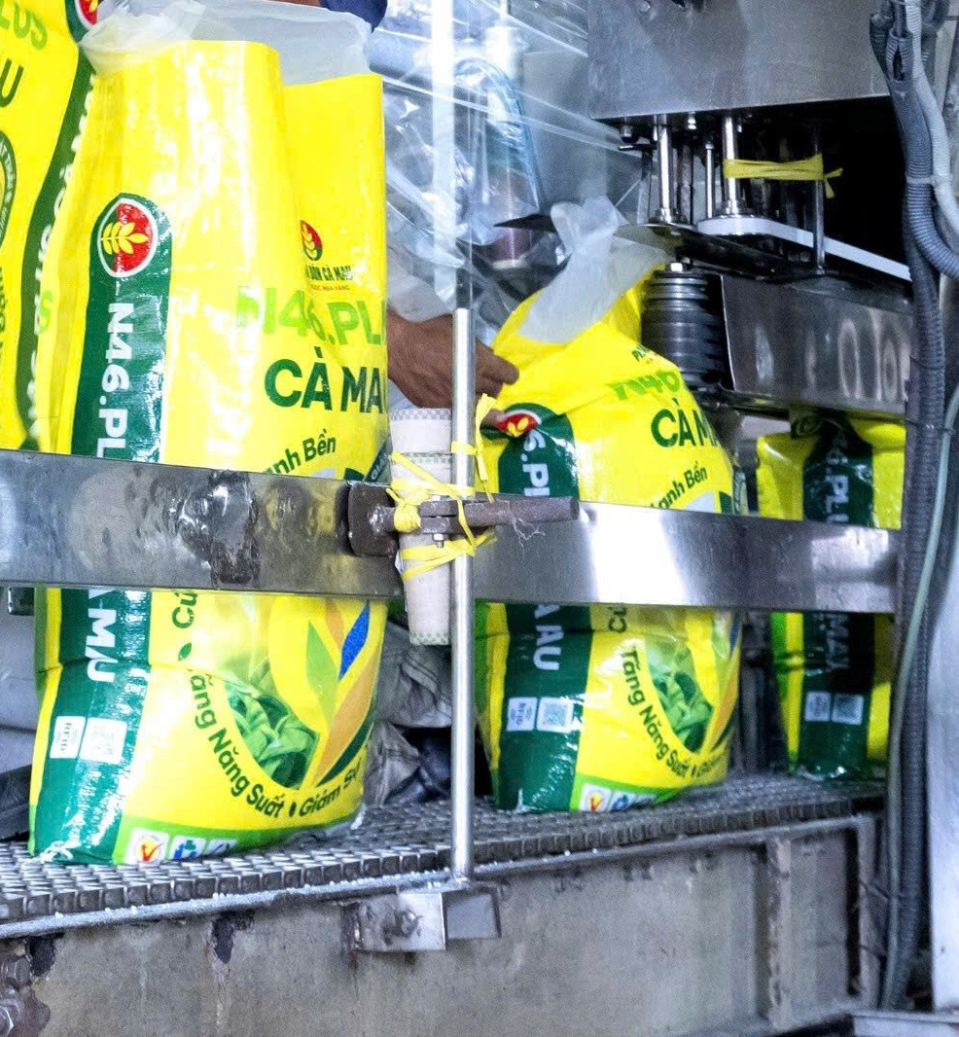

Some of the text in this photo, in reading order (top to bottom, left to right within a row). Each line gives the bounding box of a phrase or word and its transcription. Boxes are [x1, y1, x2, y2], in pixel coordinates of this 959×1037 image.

[263, 346, 387, 414] CÀ MA
[302, 428, 336, 462] Bền
[650, 397, 697, 448] CÀ
[638, 704, 670, 761] Năng
[208, 726, 251, 798] Năng
[245, 784, 286, 819] Suất
